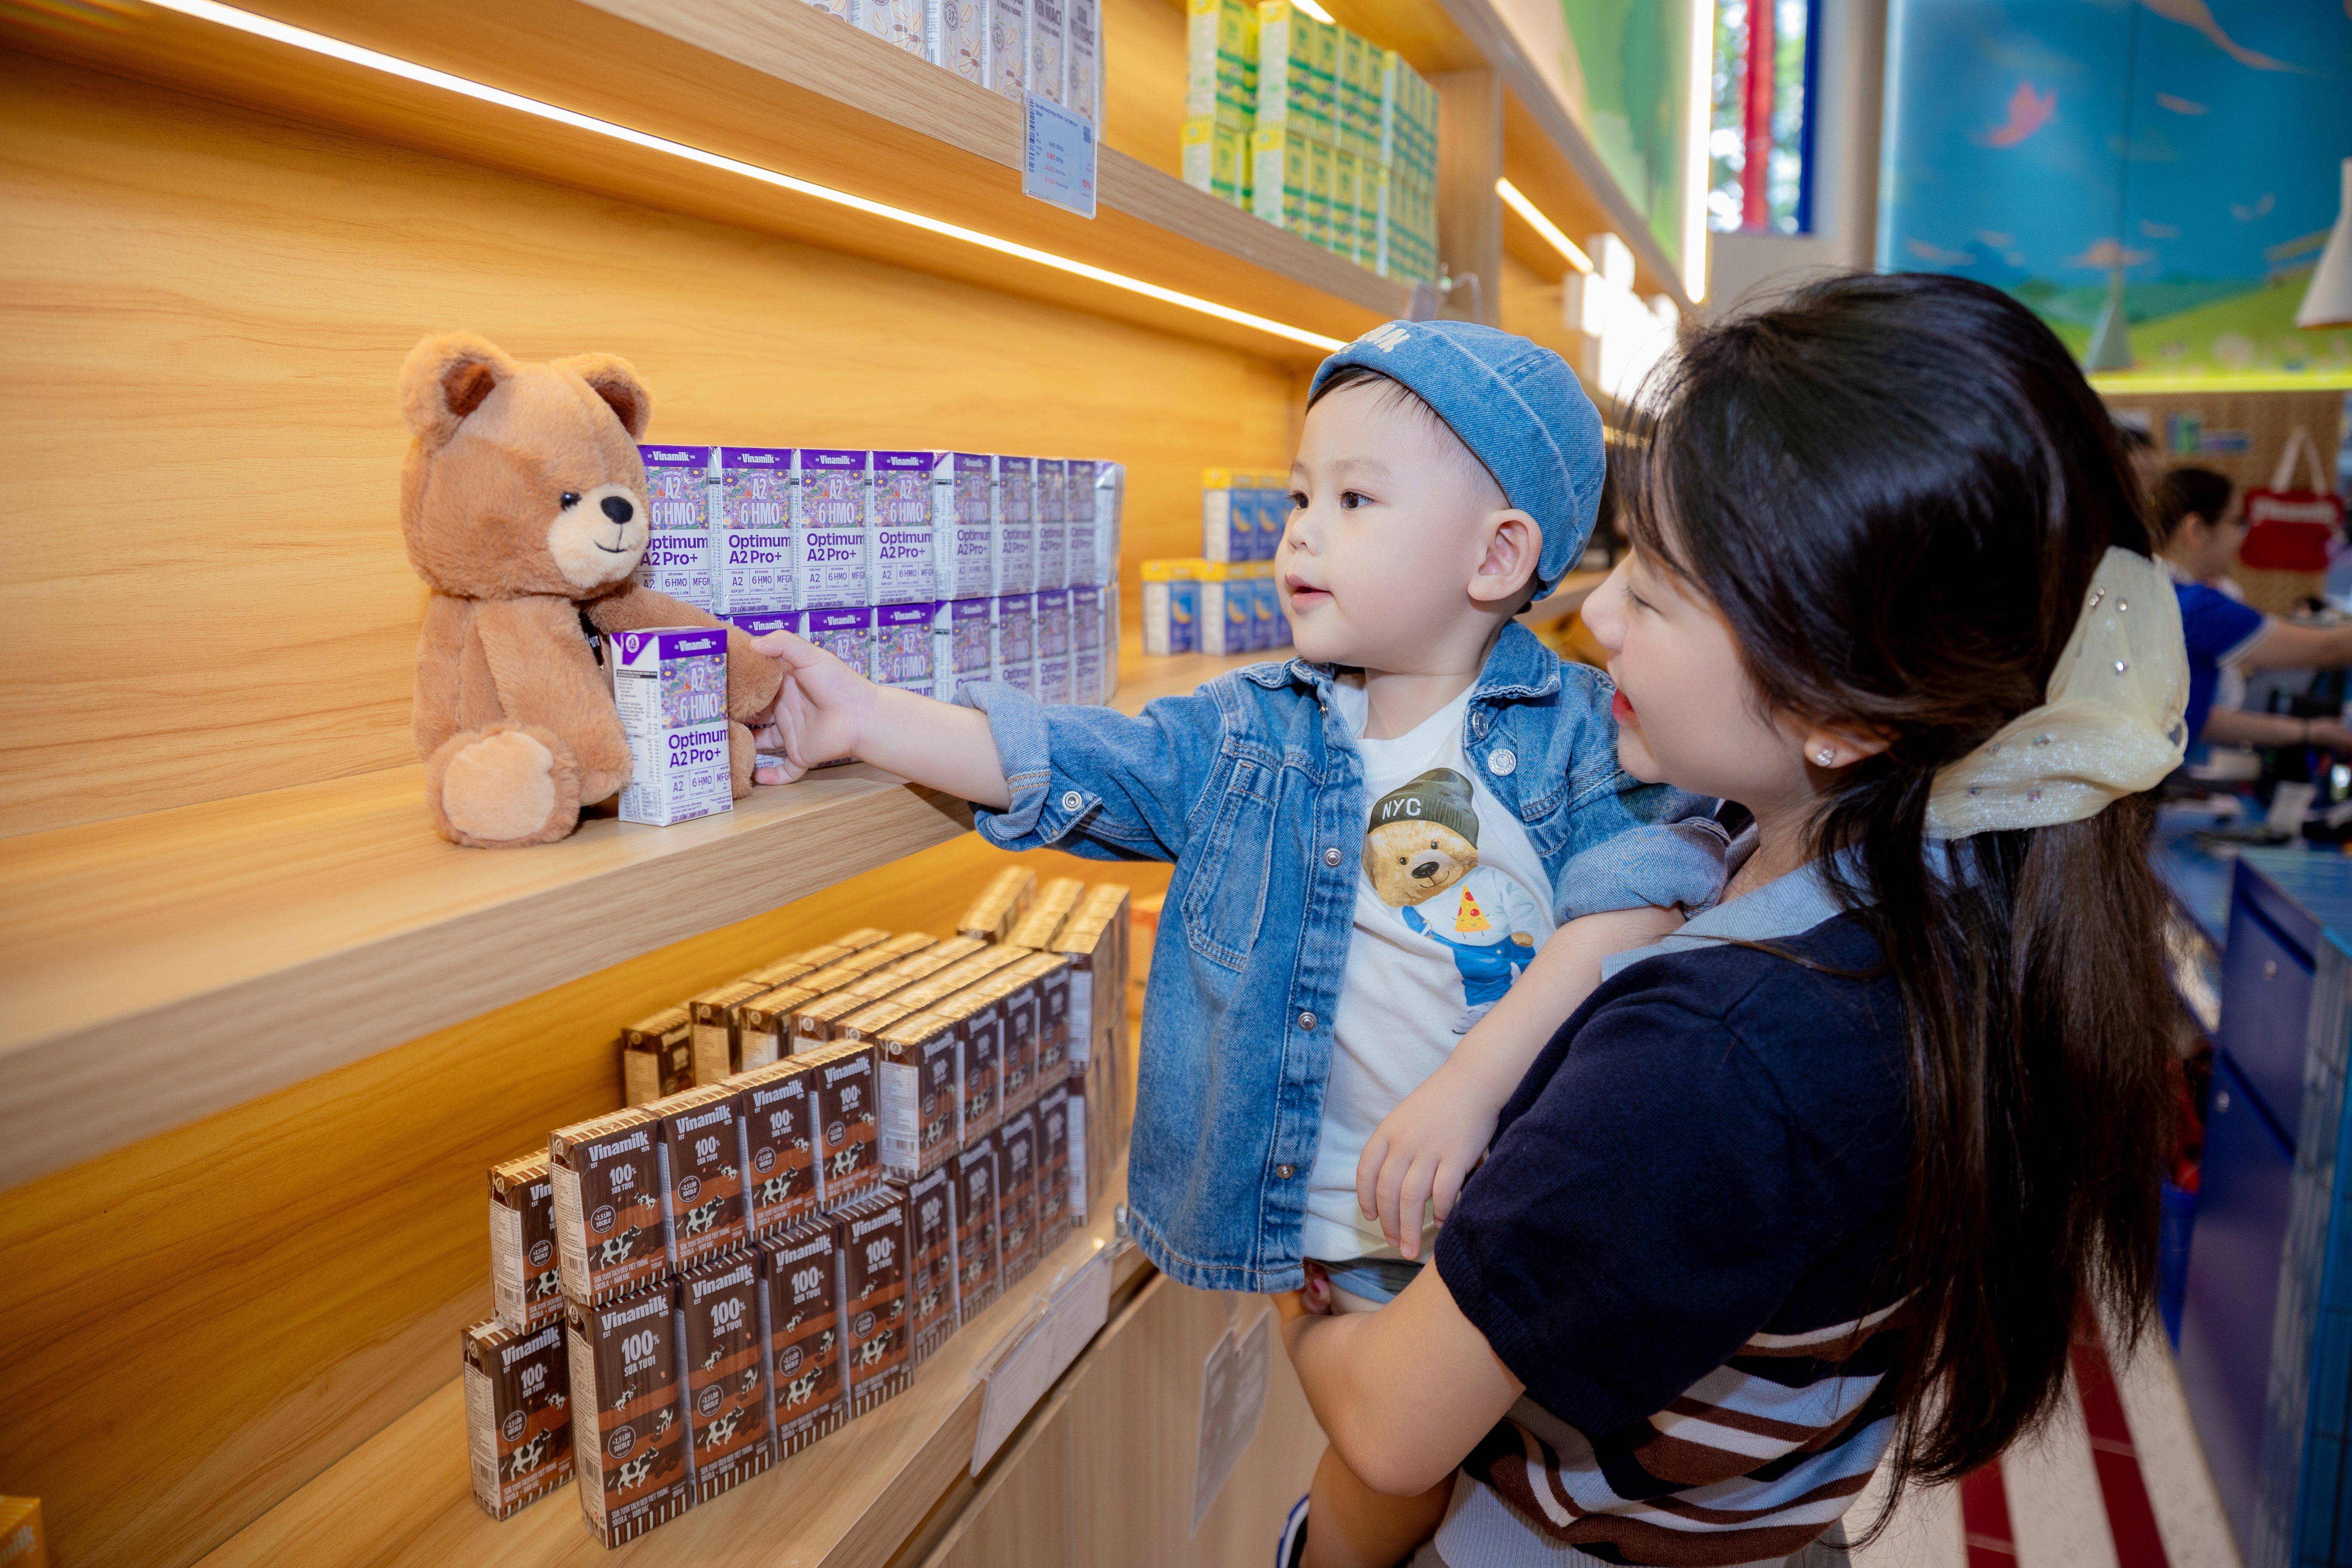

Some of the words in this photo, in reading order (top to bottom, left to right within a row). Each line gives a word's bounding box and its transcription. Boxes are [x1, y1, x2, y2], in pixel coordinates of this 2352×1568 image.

[652, 451, 689, 461] Vinamilk
[741, 453, 775, 463] Vinamilk
[819, 455, 850, 464] Vinamilk
[890, 456, 919, 466] Vinamilk
[665, 477, 681, 499] A2
[752, 478, 767, 500] A2
[829, 479, 843, 500] A2
[900, 479, 913, 500] A2
[652, 502, 661, 525] 6
[664, 502, 695, 525] HMO
[741, 502, 749, 525] 6
[752, 502, 780, 525] HMO
[818, 502, 826, 524] 6
[828, 502, 854, 524] HMO
[890, 502, 897, 523] 6
[899, 502, 924, 523] HMO
[729, 534, 791, 549] Optimum
[807, 533, 865, 547] Optimum
[957, 543, 968, 555] A2
[640, 552, 660, 566] A2
[663, 552, 698, 565] Pro+
[729, 551, 748, 564] A2
[750, 550, 782, 564] Pro+
[807, 548, 825, 561] A2
[827, 548, 856, 560] Pro+
[879, 546, 896, 559] A2
[898, 546, 925, 558] Pro+
[644, 579, 655, 588] A2
[672, 578, 687, 587] HMO
[732, 577, 743, 586] A2
[758, 576, 772, 584] HMO
[810, 574, 820, 582] A2
[882, 571, 891, 579] A2
[753, 620, 784, 631] Vinamilk
[827, 615, 856, 625] Vinamilk
[894, 610, 922, 621] Vinamilk
[678, 638, 711, 652] Vinamilk
[837, 639, 849, 659] A2
[903, 633, 915, 654] A2
[894, 657, 900, 679] 6
[903, 655, 925, 677] HMO
[691, 667, 705, 693] A2
[680, 697, 687, 722] 6
[690, 693, 718, 720] HMO
[668, 729, 728, 750] Optimum
[669, 751, 688, 768] A2
[690, 747, 721, 764] Pro+
[673, 781, 683, 793] A2
[692, 778, 697, 787] 6
[698, 776, 712, 786] HMO
[1382, 797, 1421, 820] NYC
[824, 1057, 870, 1084] Vinamilk
[753, 1079, 804, 1108] Vinamilk
[676, 1105, 732, 1134] Vinamilk
[588, 1131, 649, 1162] Vinamilk
[695, 1136, 720, 1158] 100%
[609, 1164, 637, 1186] 100%
[851, 1207, 902, 1238] Vinamilk
[775, 1235, 832, 1267] Vinamilk
[692, 1265, 753, 1298] Vinamilk
[791, 1266, 825, 1295] 100%
[601, 1295, 668, 1331] Vinamilk
[659, 1310, 669, 1318] 1976
[710, 1298, 746, 1327] 100%
[501, 1326, 560, 1366] Vinamilk
[622, 1330, 660, 1365] 100%
[521, 1363, 548, 1389] 100%
